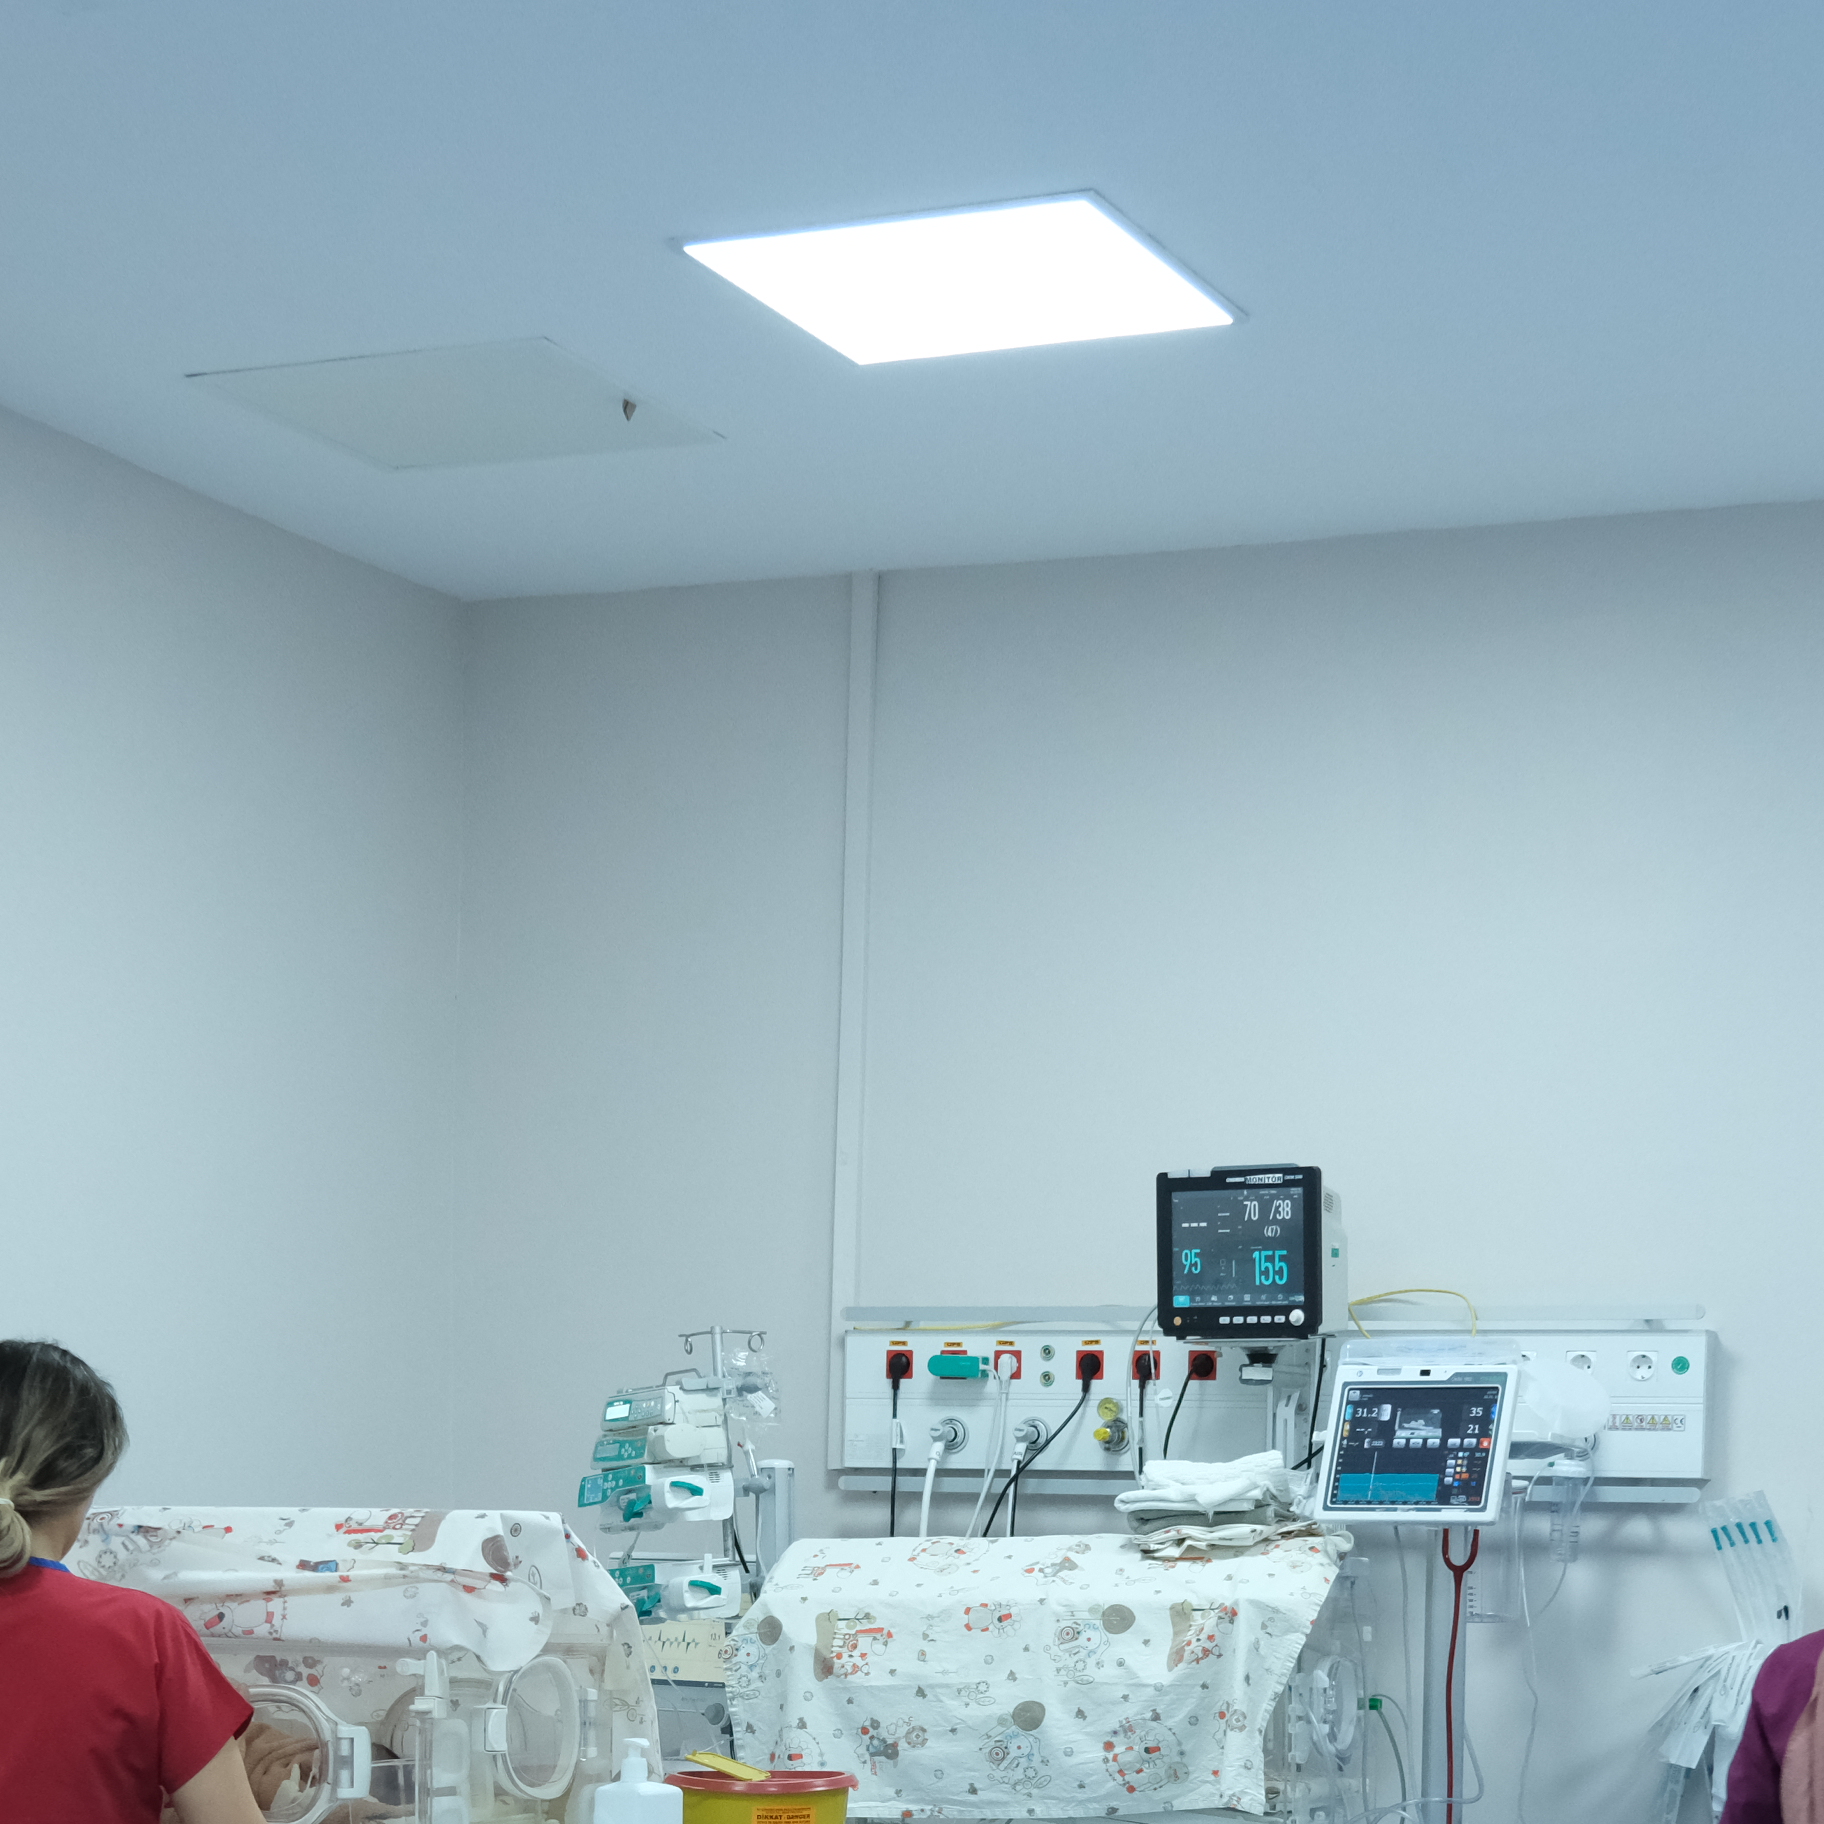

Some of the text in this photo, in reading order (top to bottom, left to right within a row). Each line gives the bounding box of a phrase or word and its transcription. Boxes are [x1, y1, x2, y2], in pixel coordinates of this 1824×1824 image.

[1243, 1200, 1292, 1222] 70 /38
[1181, 1248, 1201, 1275] 95
[1252, 1250, 1288, 1286] 155
[1355, 1407, 1378, 1418] 31.2
[1469, 1407, 1484, 1417] 35
[1466, 1424, 1480, 1434] 21
